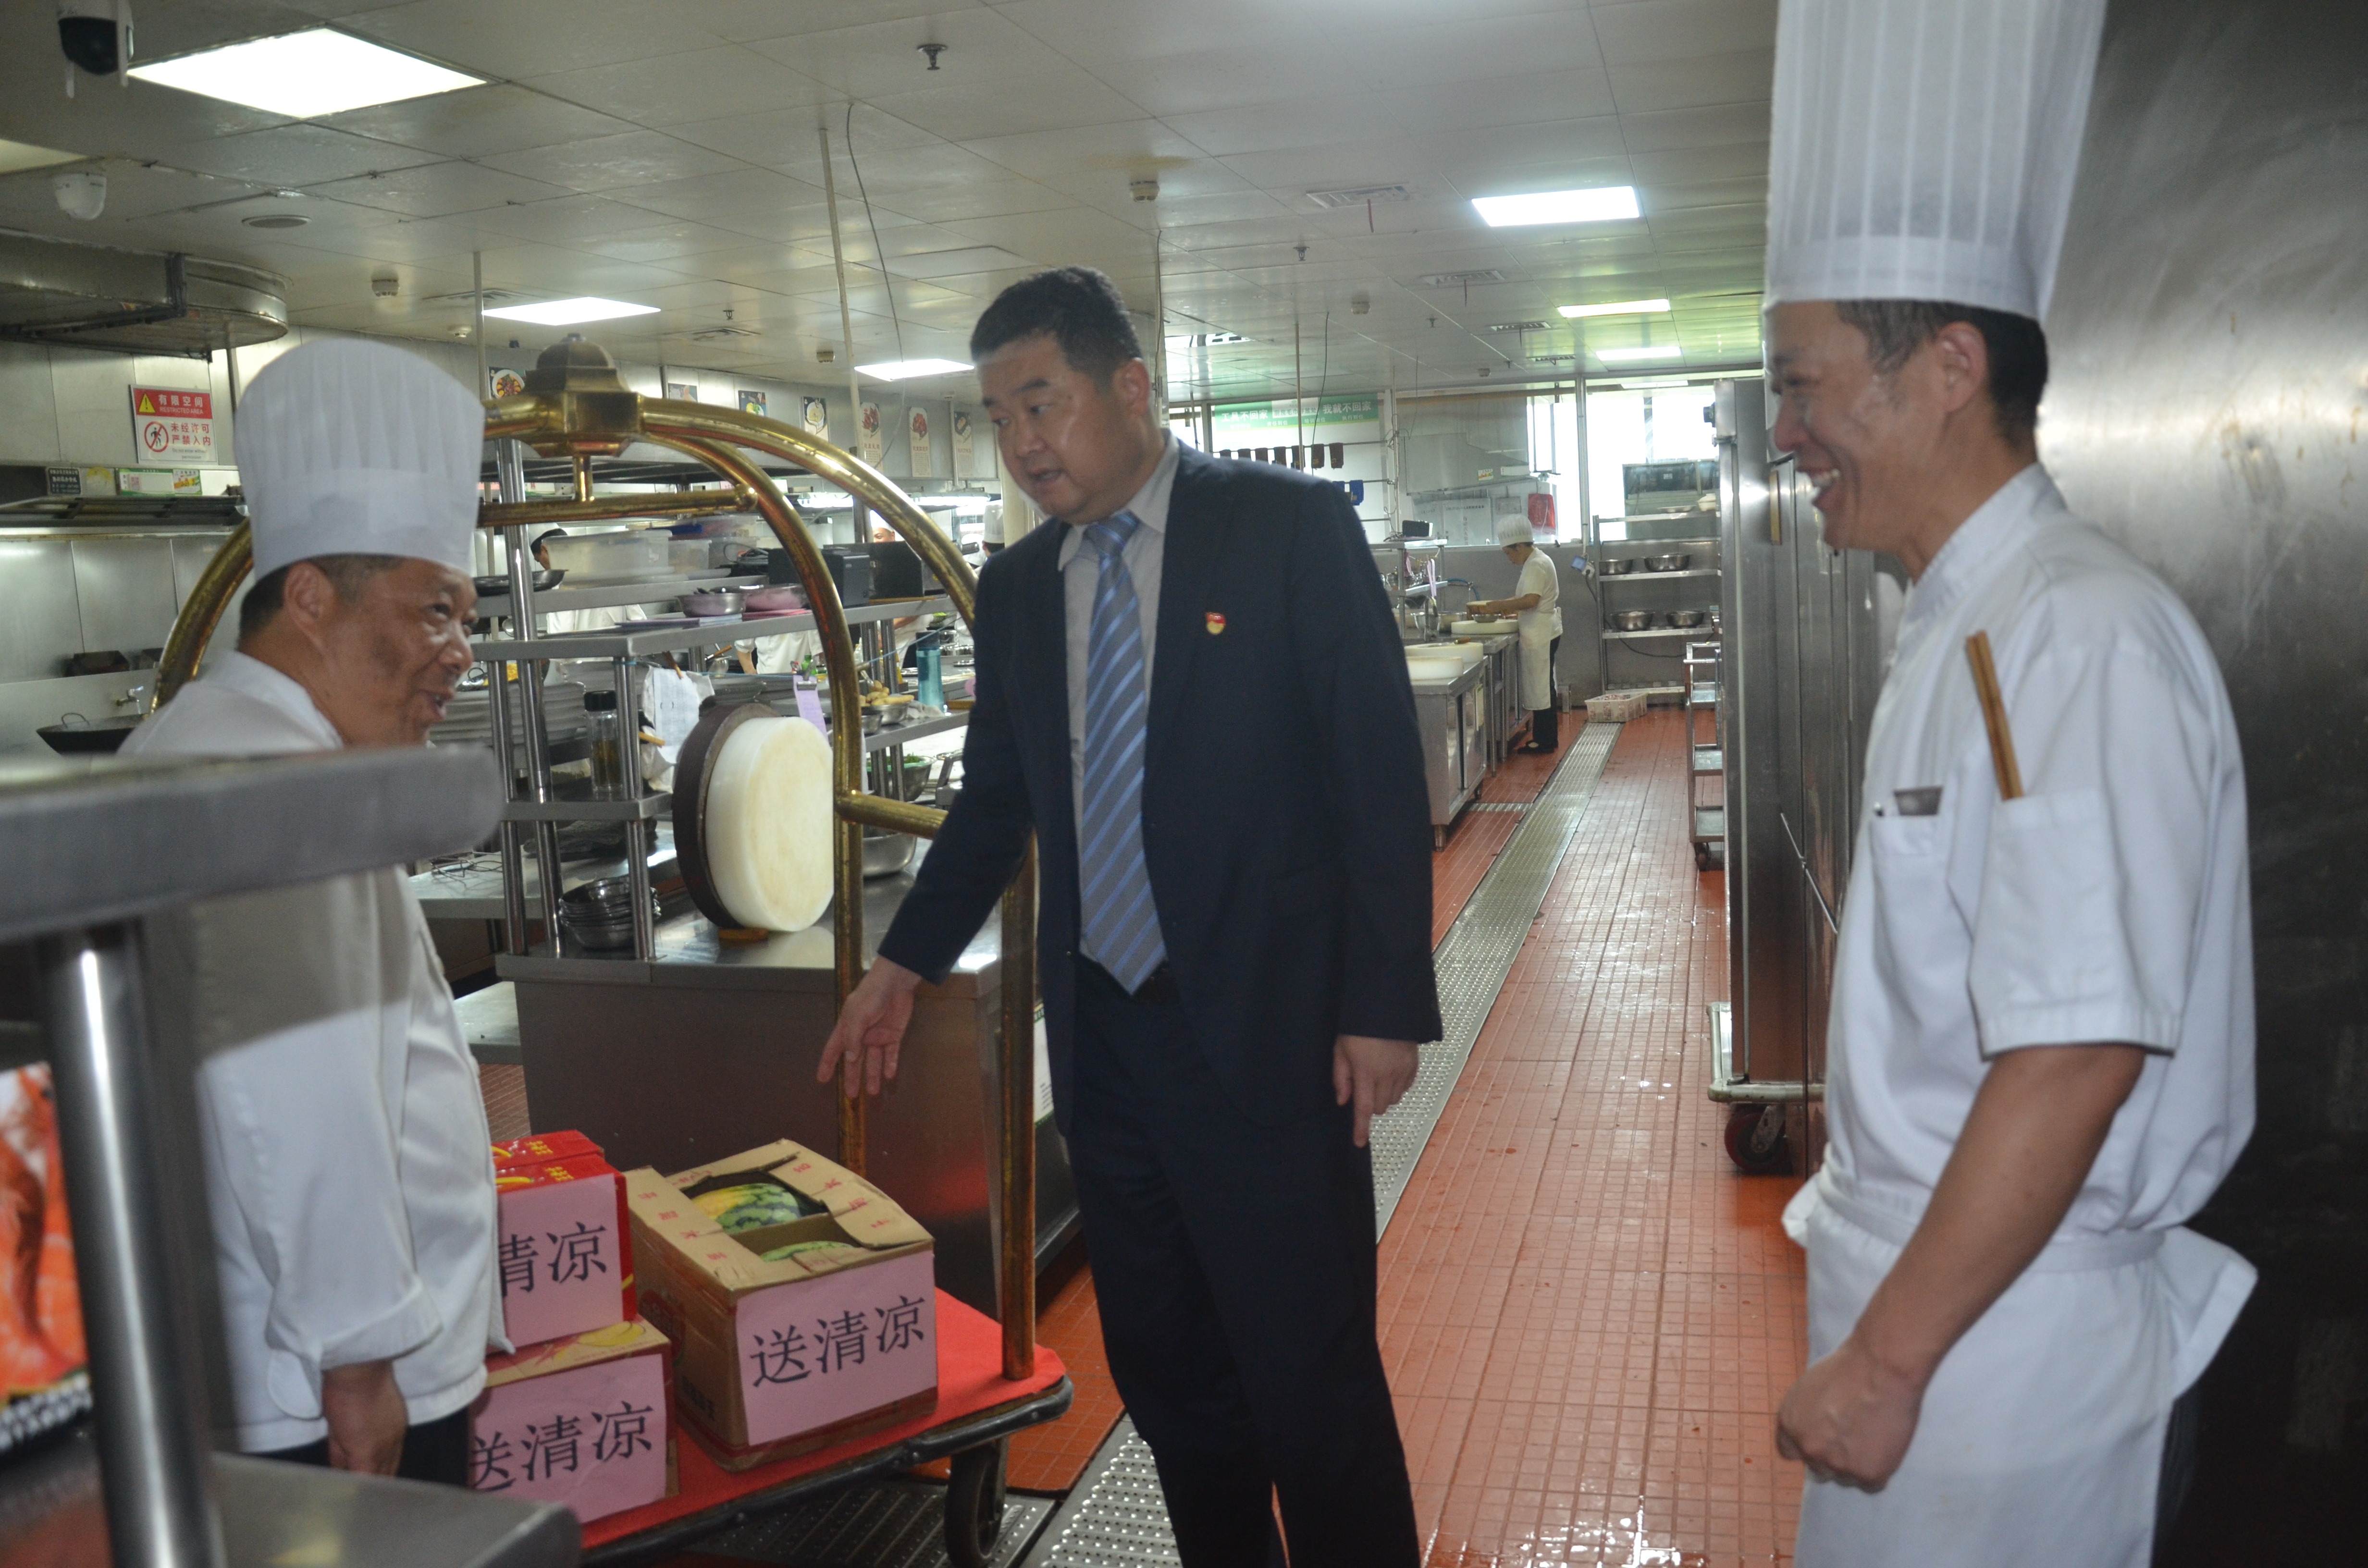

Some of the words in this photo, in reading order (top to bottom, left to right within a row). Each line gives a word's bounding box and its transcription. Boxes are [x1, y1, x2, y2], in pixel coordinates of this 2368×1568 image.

[159, 394, 203, 407] 有限空间
[1323, 401, 1371, 414] 我就不回家
[1221, 410, 1268, 422] 工具不回家
[171, 423, 210, 433] 未经许可
[172, 434, 211, 446] 严禁入内
[750, 1296, 925, 1387] 送清凉
